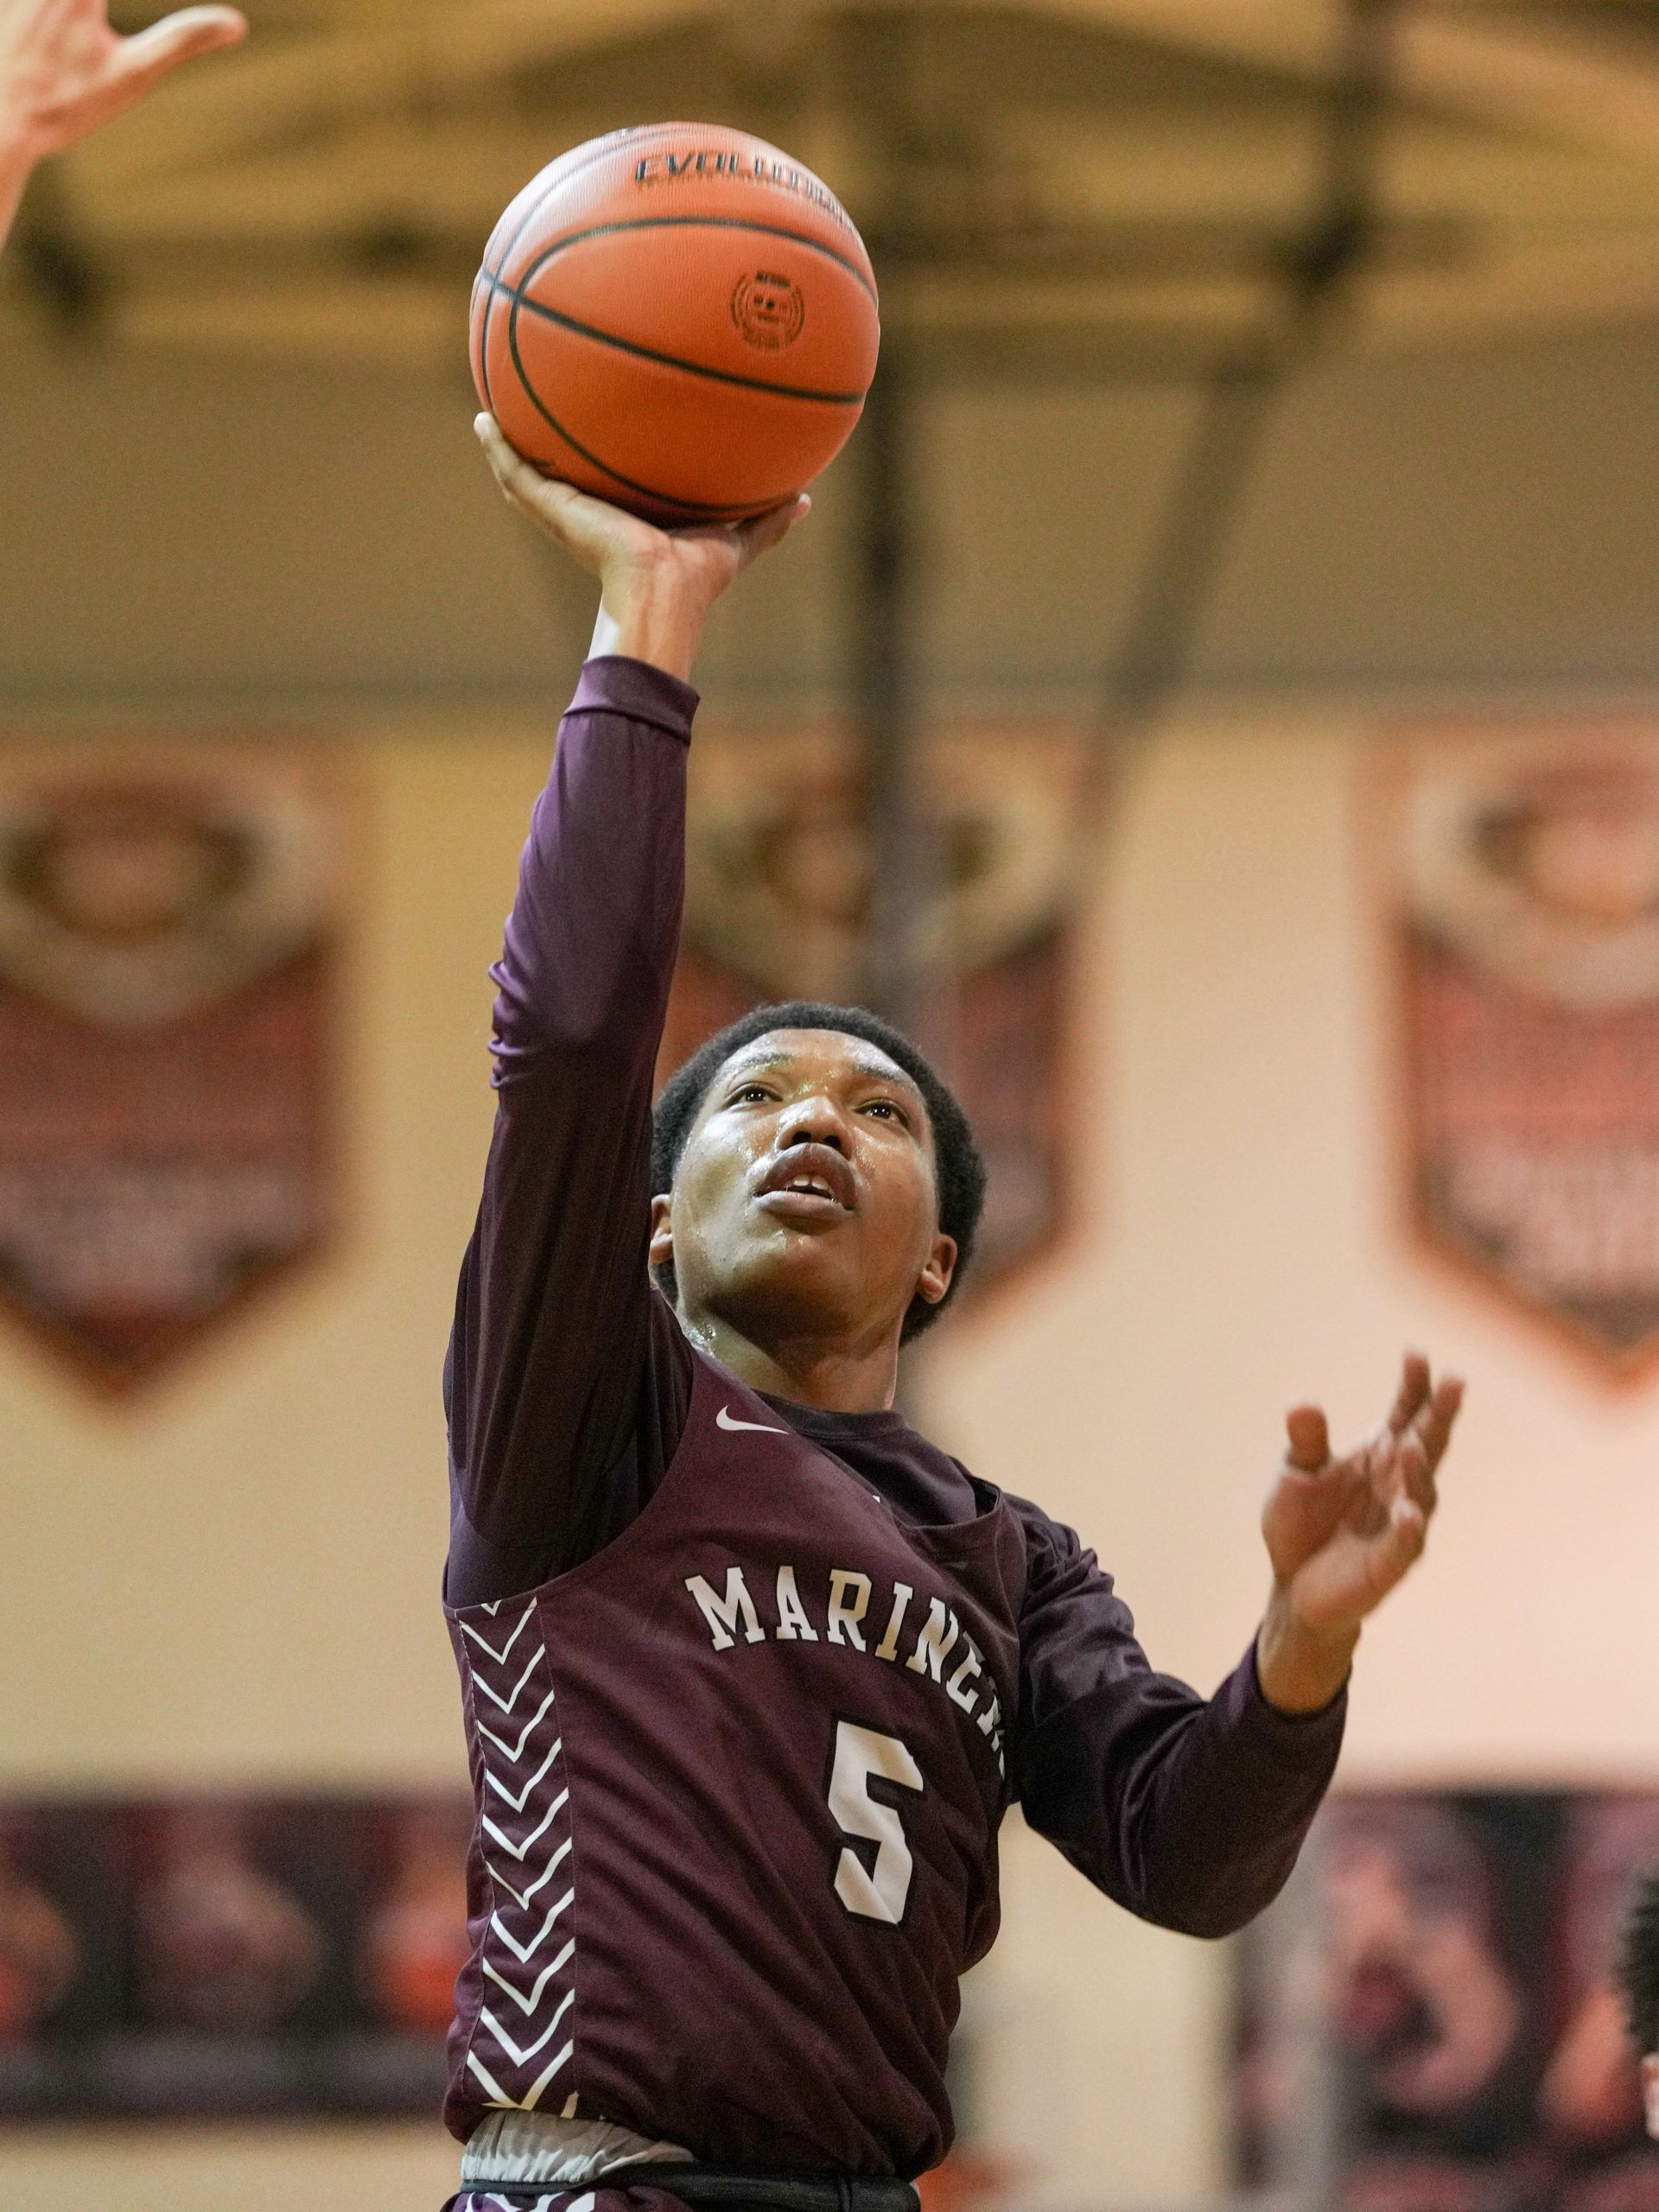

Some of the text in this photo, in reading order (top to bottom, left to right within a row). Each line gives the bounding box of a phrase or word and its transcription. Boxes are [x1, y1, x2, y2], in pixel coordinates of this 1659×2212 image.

[636, 151, 854, 234] EVOLUT
[685, 1566, 1005, 1781] MARINE
[828, 1720, 924, 1925] 5
